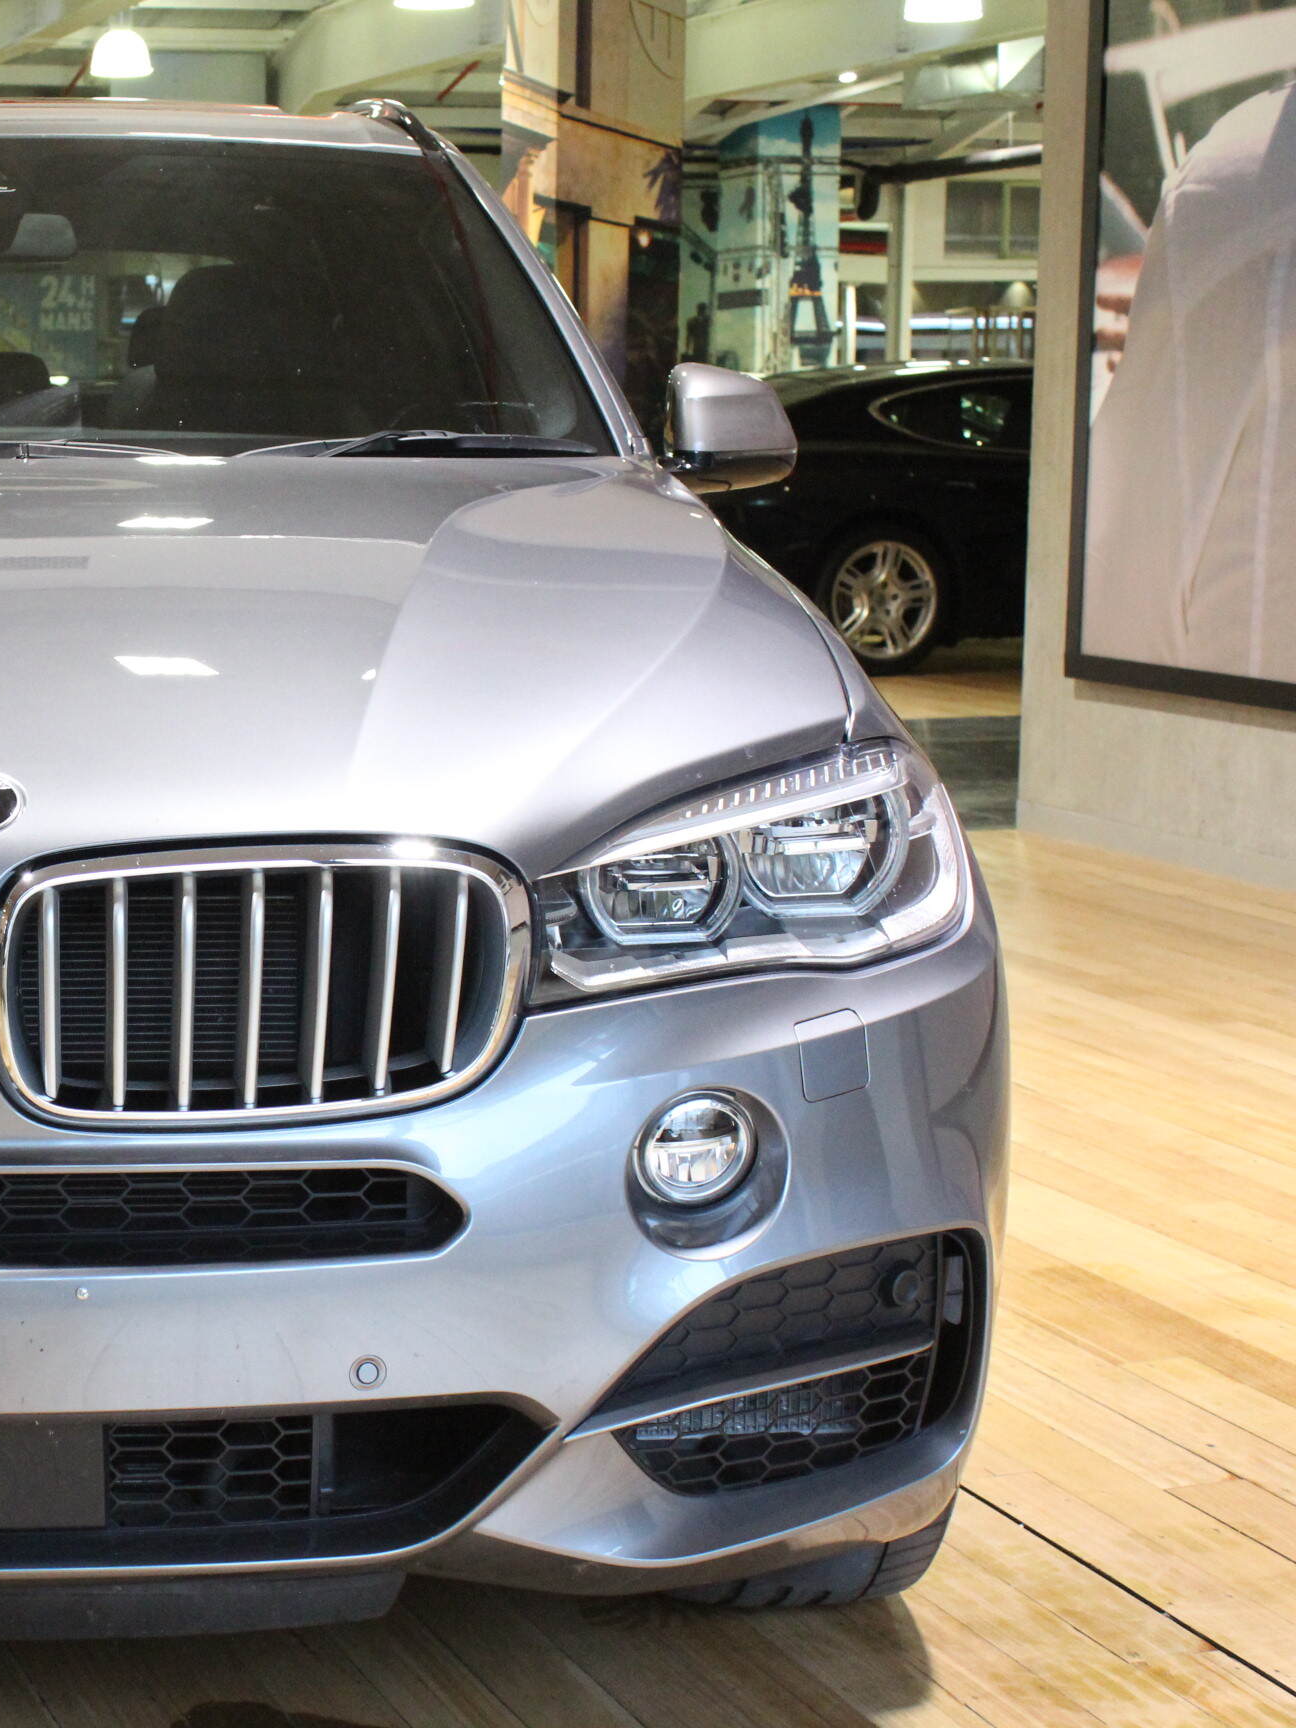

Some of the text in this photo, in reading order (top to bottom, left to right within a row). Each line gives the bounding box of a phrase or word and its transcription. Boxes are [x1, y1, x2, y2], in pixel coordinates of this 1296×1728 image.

[40, 275, 95, 308] 24 H
[39, 311, 94, 331] MANS
